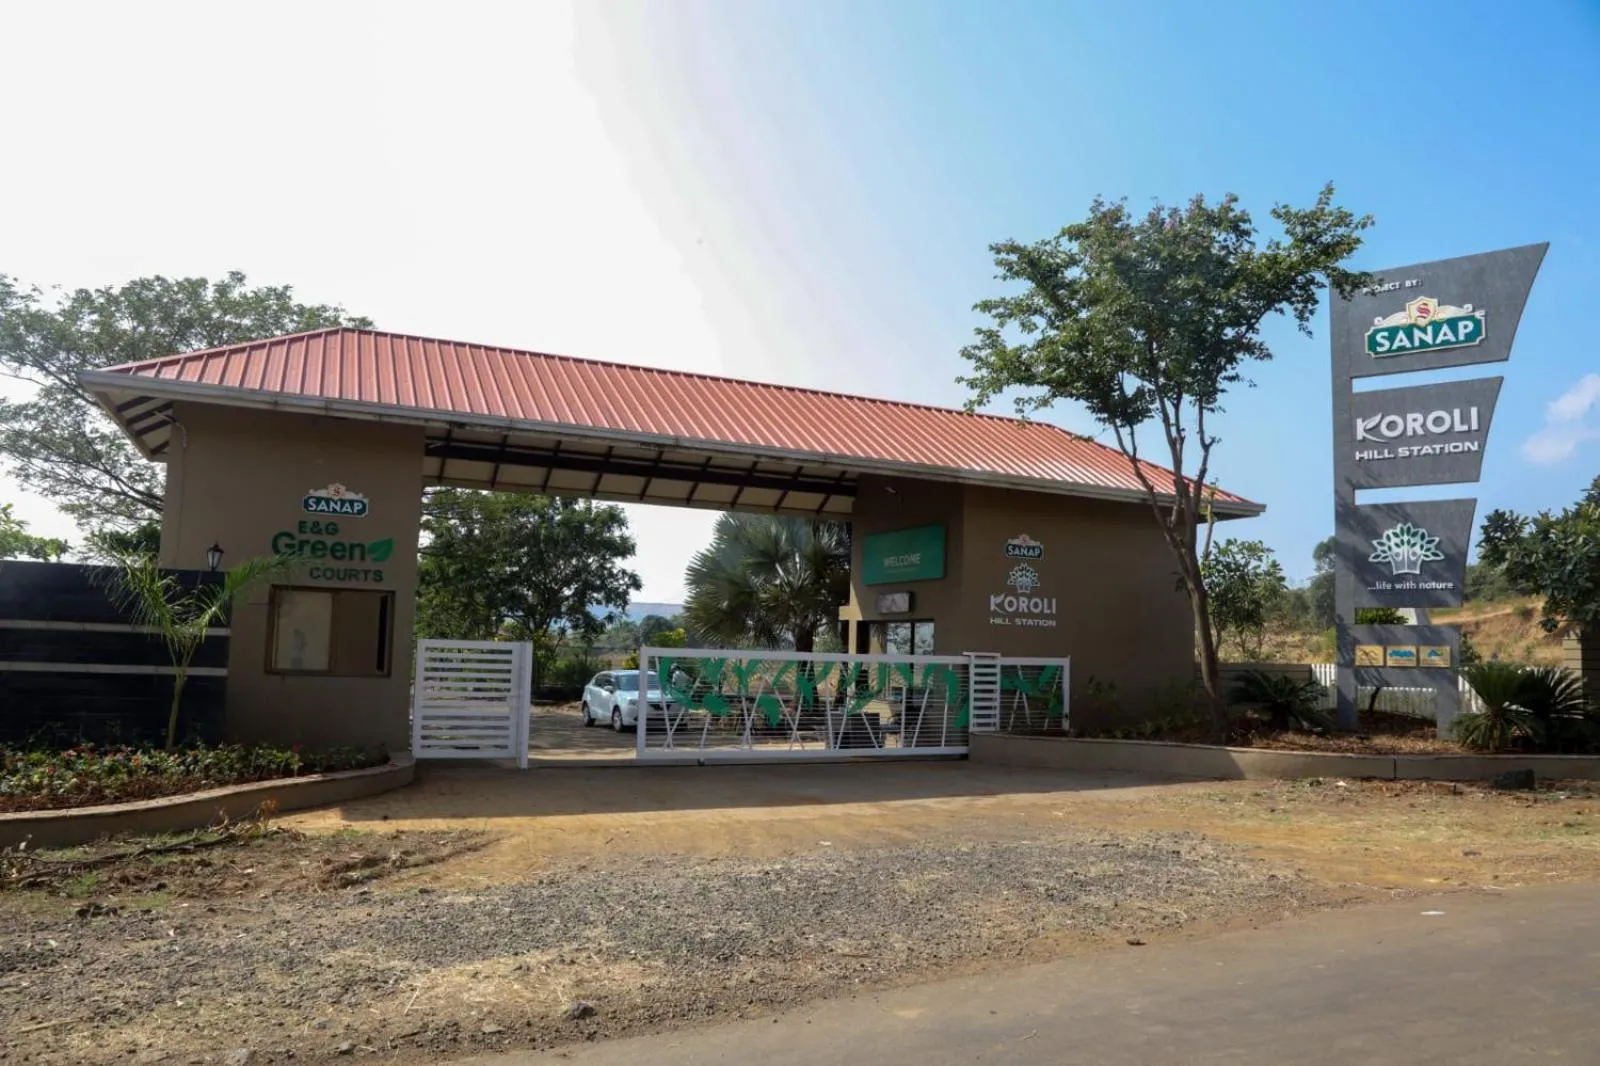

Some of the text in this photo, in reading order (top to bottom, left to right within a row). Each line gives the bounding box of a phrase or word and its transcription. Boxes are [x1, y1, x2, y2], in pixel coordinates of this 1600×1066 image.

[1362, 281, 1400, 295] POJECT
[1375, 320, 1474, 352] SANAP
[1356, 406, 1479, 443] KOROLI
[1355, 440, 1479, 462] HILL STATION
[307, 498, 363, 514] SANAP
[298, 520, 340, 536] E&G
[271, 531, 367, 561] Green
[1007, 545, 1041, 558] SANAP
[882, 553, 921, 568] WELCOME
[309, 567, 384, 583] COURTS
[1394, 580, 1416, 590] with
[1419, 580, 1454, 590] nature
[989, 592, 1057, 615] KOROLI
[989, 617, 1057, 628] HILL STATION
